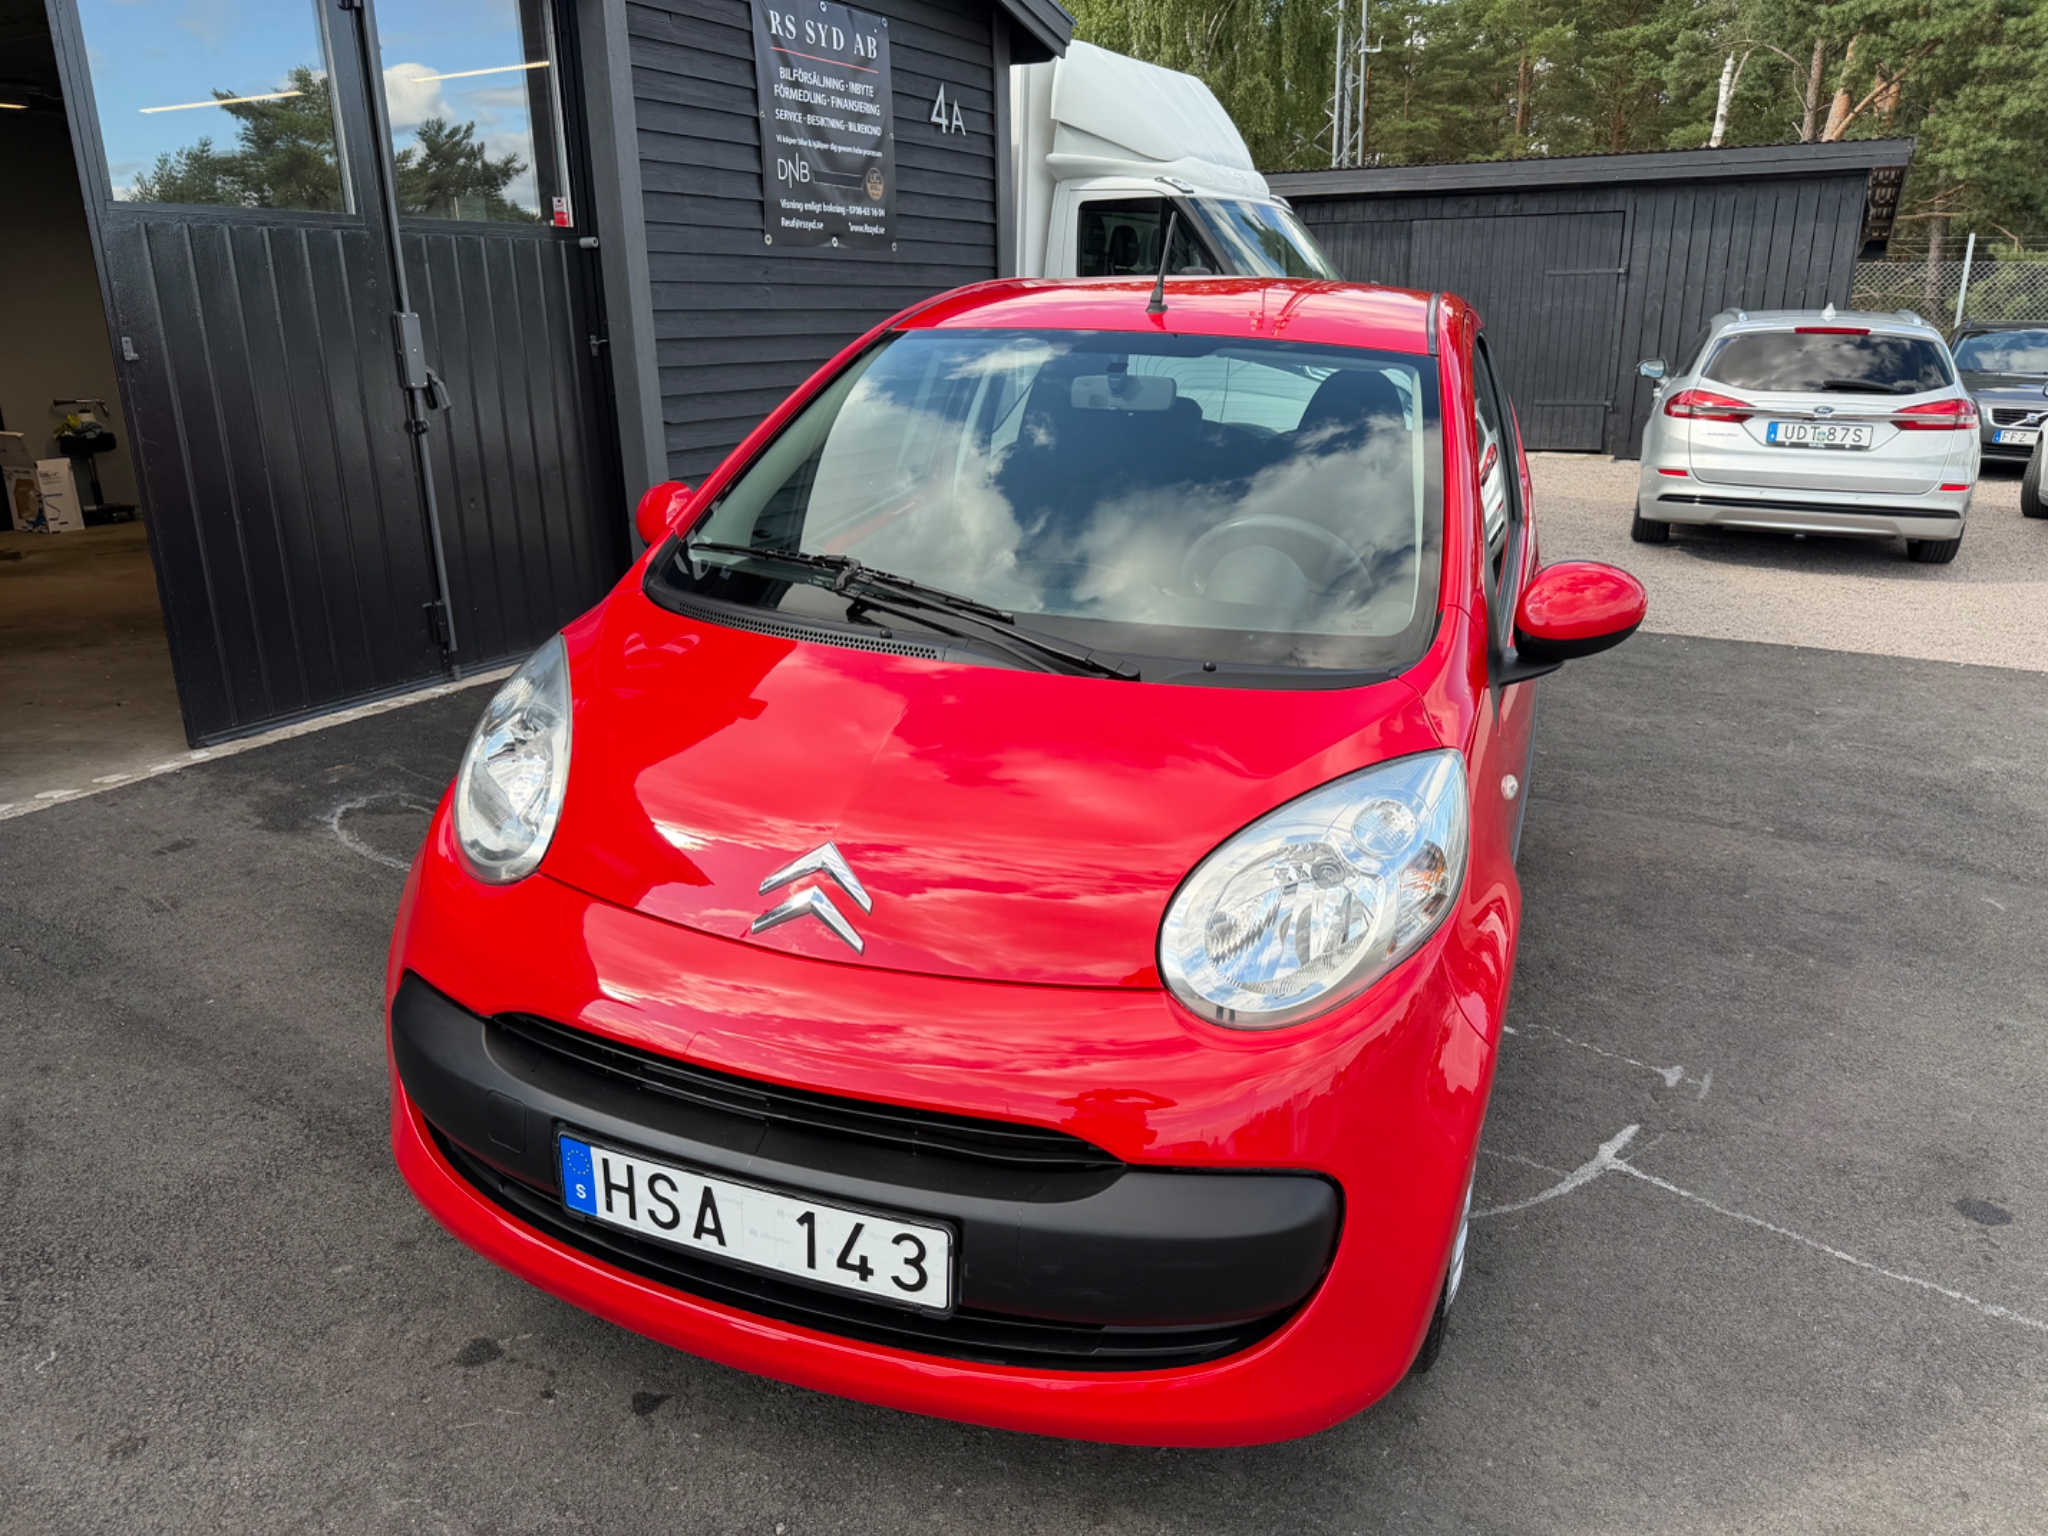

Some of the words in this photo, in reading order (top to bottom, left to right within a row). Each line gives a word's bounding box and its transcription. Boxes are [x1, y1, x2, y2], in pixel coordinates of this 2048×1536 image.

[769, 10, 797, 39] RS
[805, 20, 845, 50] SYD
[853, 33, 878, 59] AB
[779, 66, 846, 92] BILFÖRSÄLJNING
[848, 81, 875, 98] INBYTE
[773, 83, 827, 106] FÖRMEDLING
[830, 95, 881, 116] FINANSIERING
[775, 108, 803, 123] SERVICE
[930, 82, 966, 136] 4A
[777, 153, 811, 188] DNB
[780, 199, 804, 213] Visning
[804, 201, 822, 214] enligt
[822, 202, 846, 216] bokning
[1784, 425, 1821, 441] UDT
[1826, 427, 1863, 444] 87S
[576, 1183, 587, 1199] S
[601, 1157, 727, 1248] HSA
[796, 1211, 928, 1293] 143
